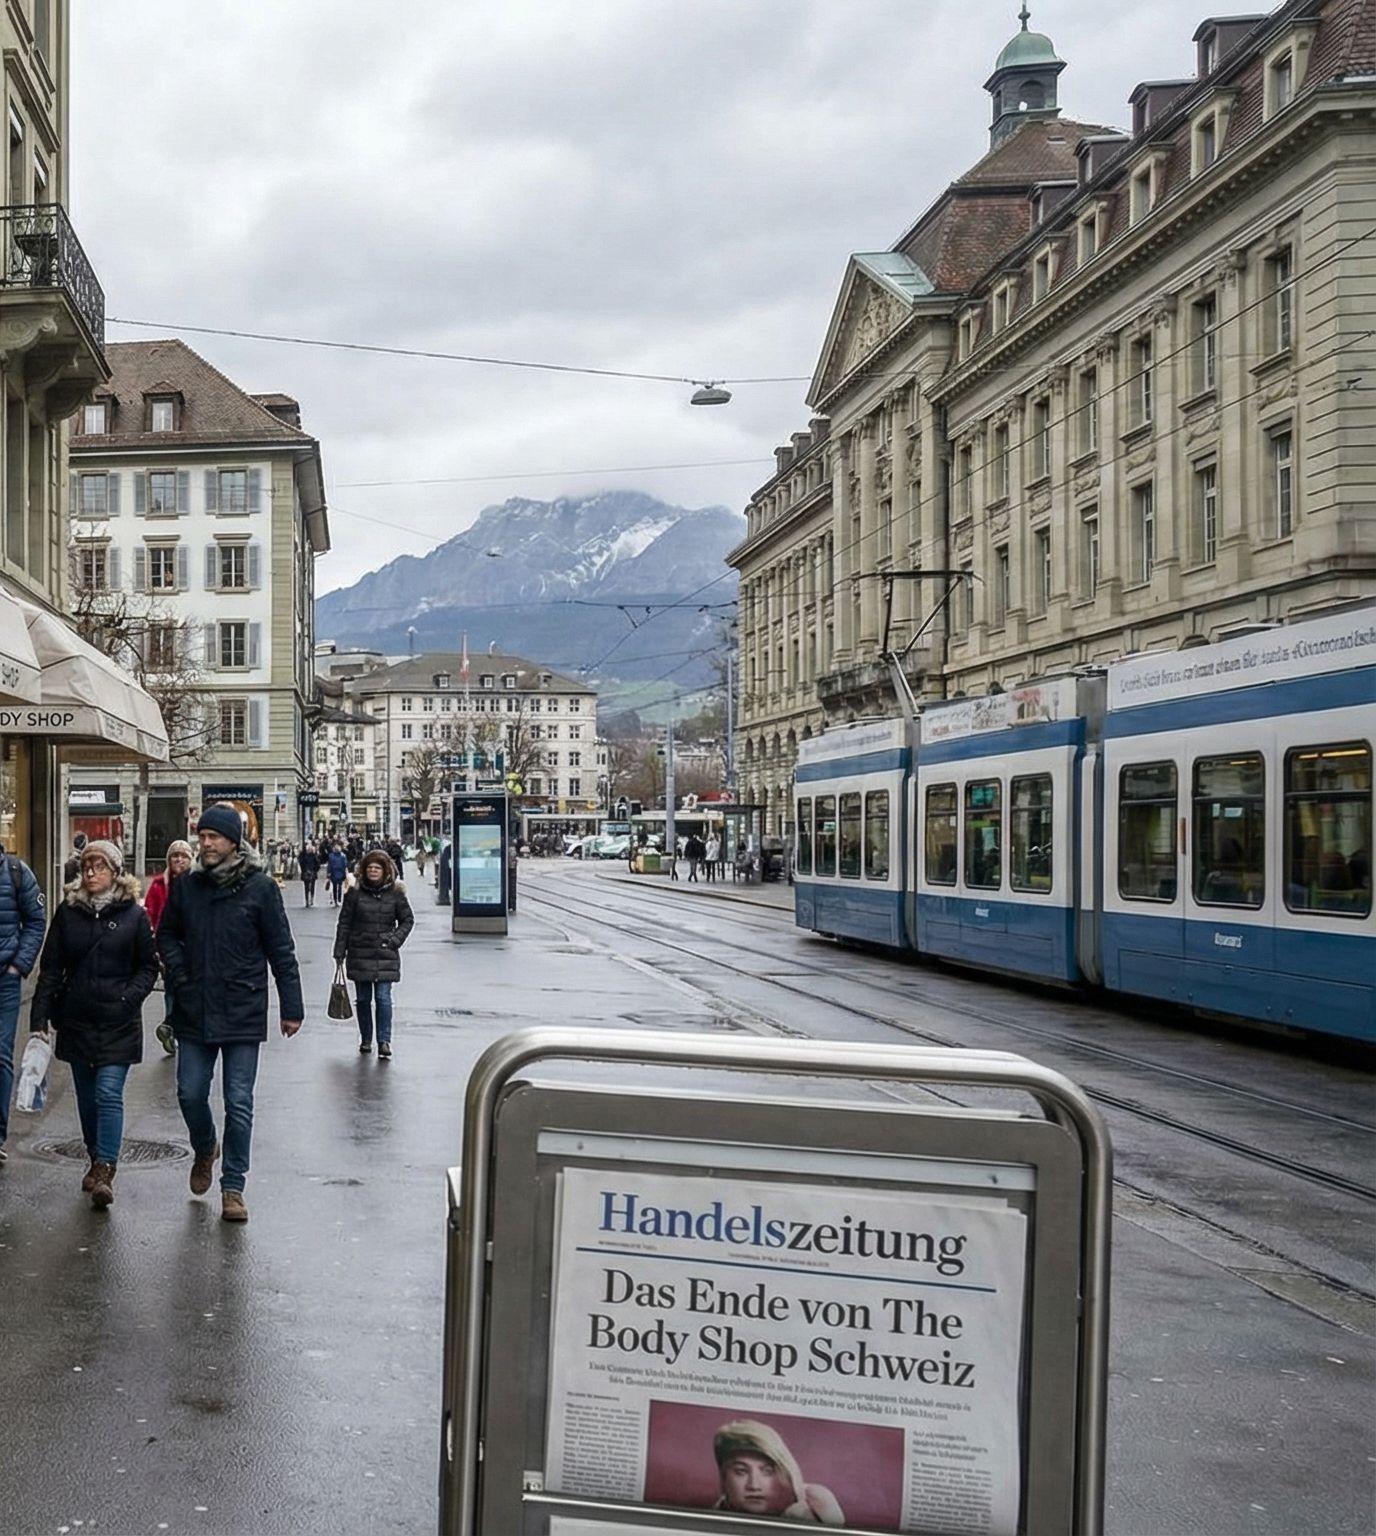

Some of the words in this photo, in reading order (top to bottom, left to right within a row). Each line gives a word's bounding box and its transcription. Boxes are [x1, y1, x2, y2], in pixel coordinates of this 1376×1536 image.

[27, 712, 74, 727] SHOP
[598, 1190, 967, 1277] Handelszeitung
[602, 1268, 676, 1309] Das
[686, 1276, 790, 1322] Ende
[798, 1298, 873, 1331] von
[882, 1297, 964, 1340] The
[586, 1313, 690, 1364] Body
[697, 1324, 799, 1377] Shop
[807, 1336, 976, 1389] Schweiz
